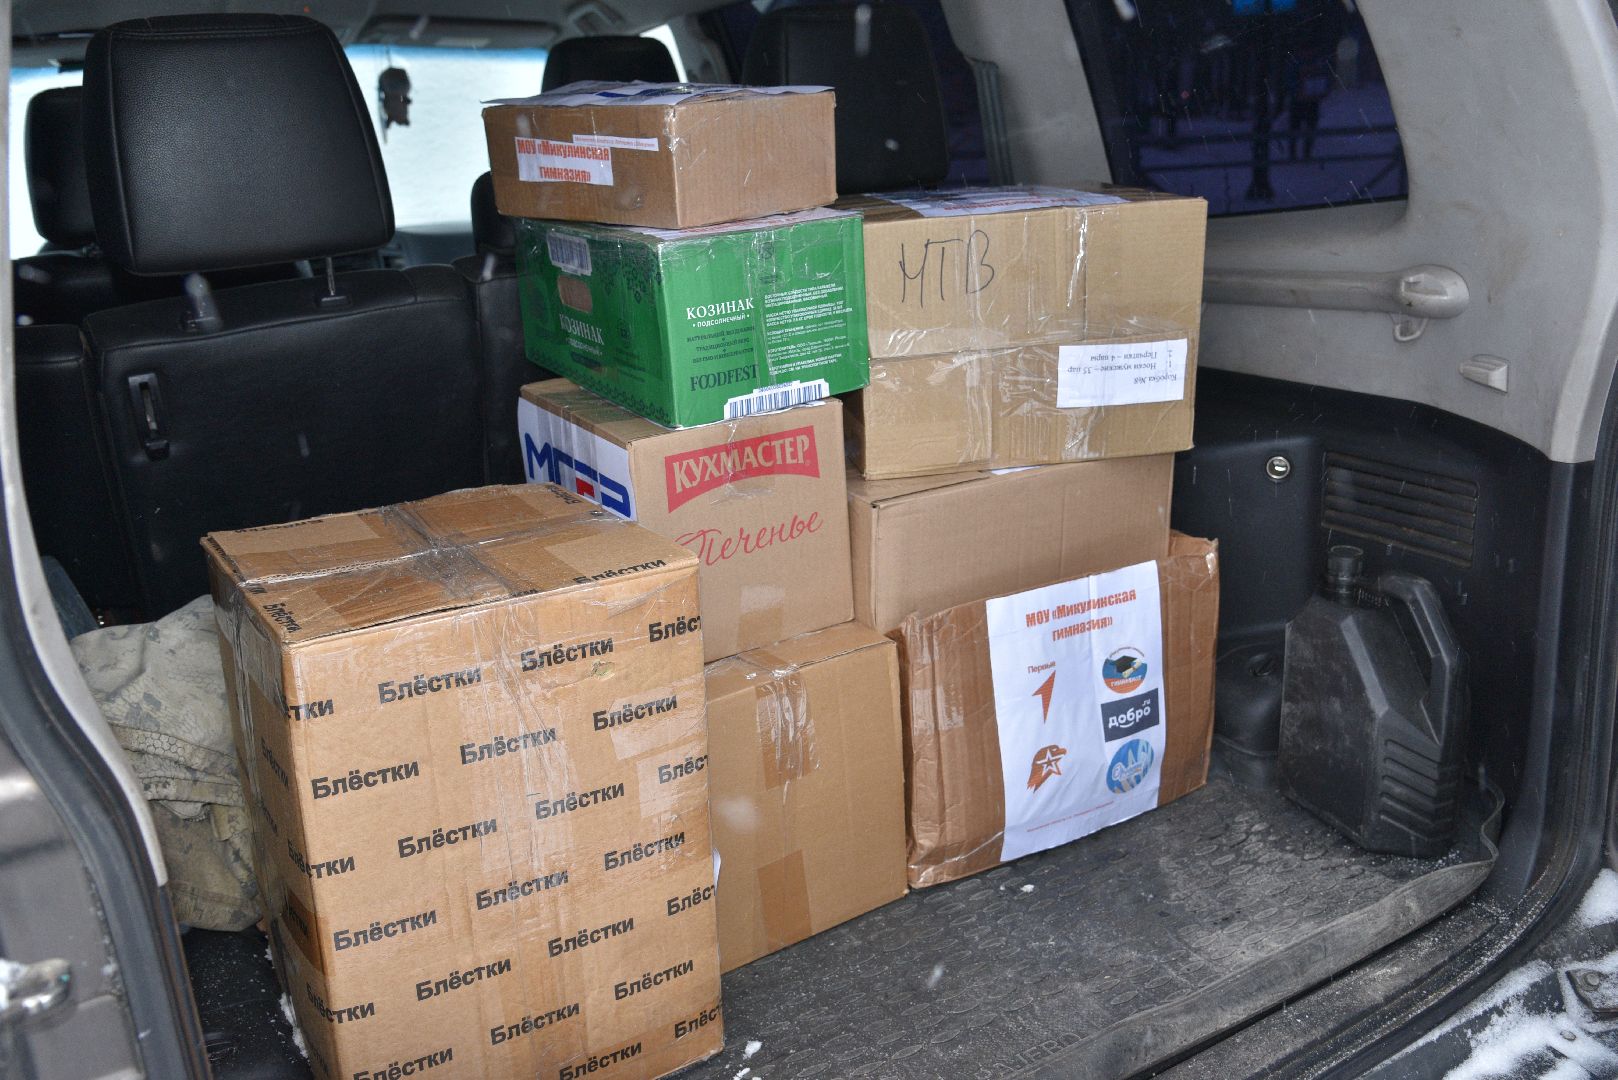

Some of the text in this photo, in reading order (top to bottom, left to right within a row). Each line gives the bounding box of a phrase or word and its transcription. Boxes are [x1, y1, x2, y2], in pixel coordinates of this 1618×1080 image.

[516, 138, 536, 154] МОУ
[537, 140, 610, 161] «Микулинская
[686, 297, 755, 320] КОЗИНАК
[559, 313, 605, 345] КОЗИНАК
[689, 364, 758, 391] FOODFEST
[672, 434, 810, 494] КУХМАСТЕР
[675, 511, 823, 566] Печенье
[1025, 588, 1137, 628] МОУ «Микулинская
[1052, 616, 1113, 642] гимназия»
[520, 637, 614, 672] Блёстки
[378, 667, 482, 704] Блёстки
[593, 695, 678, 732] Блёстки
[1108, 707, 1151, 728] добро
[460, 727, 557, 765] Блёстки
[311, 760, 420, 800] Блёстки
[535, 781, 626, 820] Блёстки
[397, 818, 498, 859] Блёстки
[603, 831, 686, 872] Блёстки
[475, 868, 570, 911] Блёстки
[666, 884, 715, 917] Блёс
[333, 908, 438, 951] Блёстки
[547, 917, 636, 958] Блёстки
[415, 957, 512, 1002] Блёстки
[614, 959, 695, 1001] Блёстки
[490, 1003, 581, 1046] Блёстки
[674, 1004, 720, 1039] Блёс
[558, 1042, 643, 1080] Блёстки
